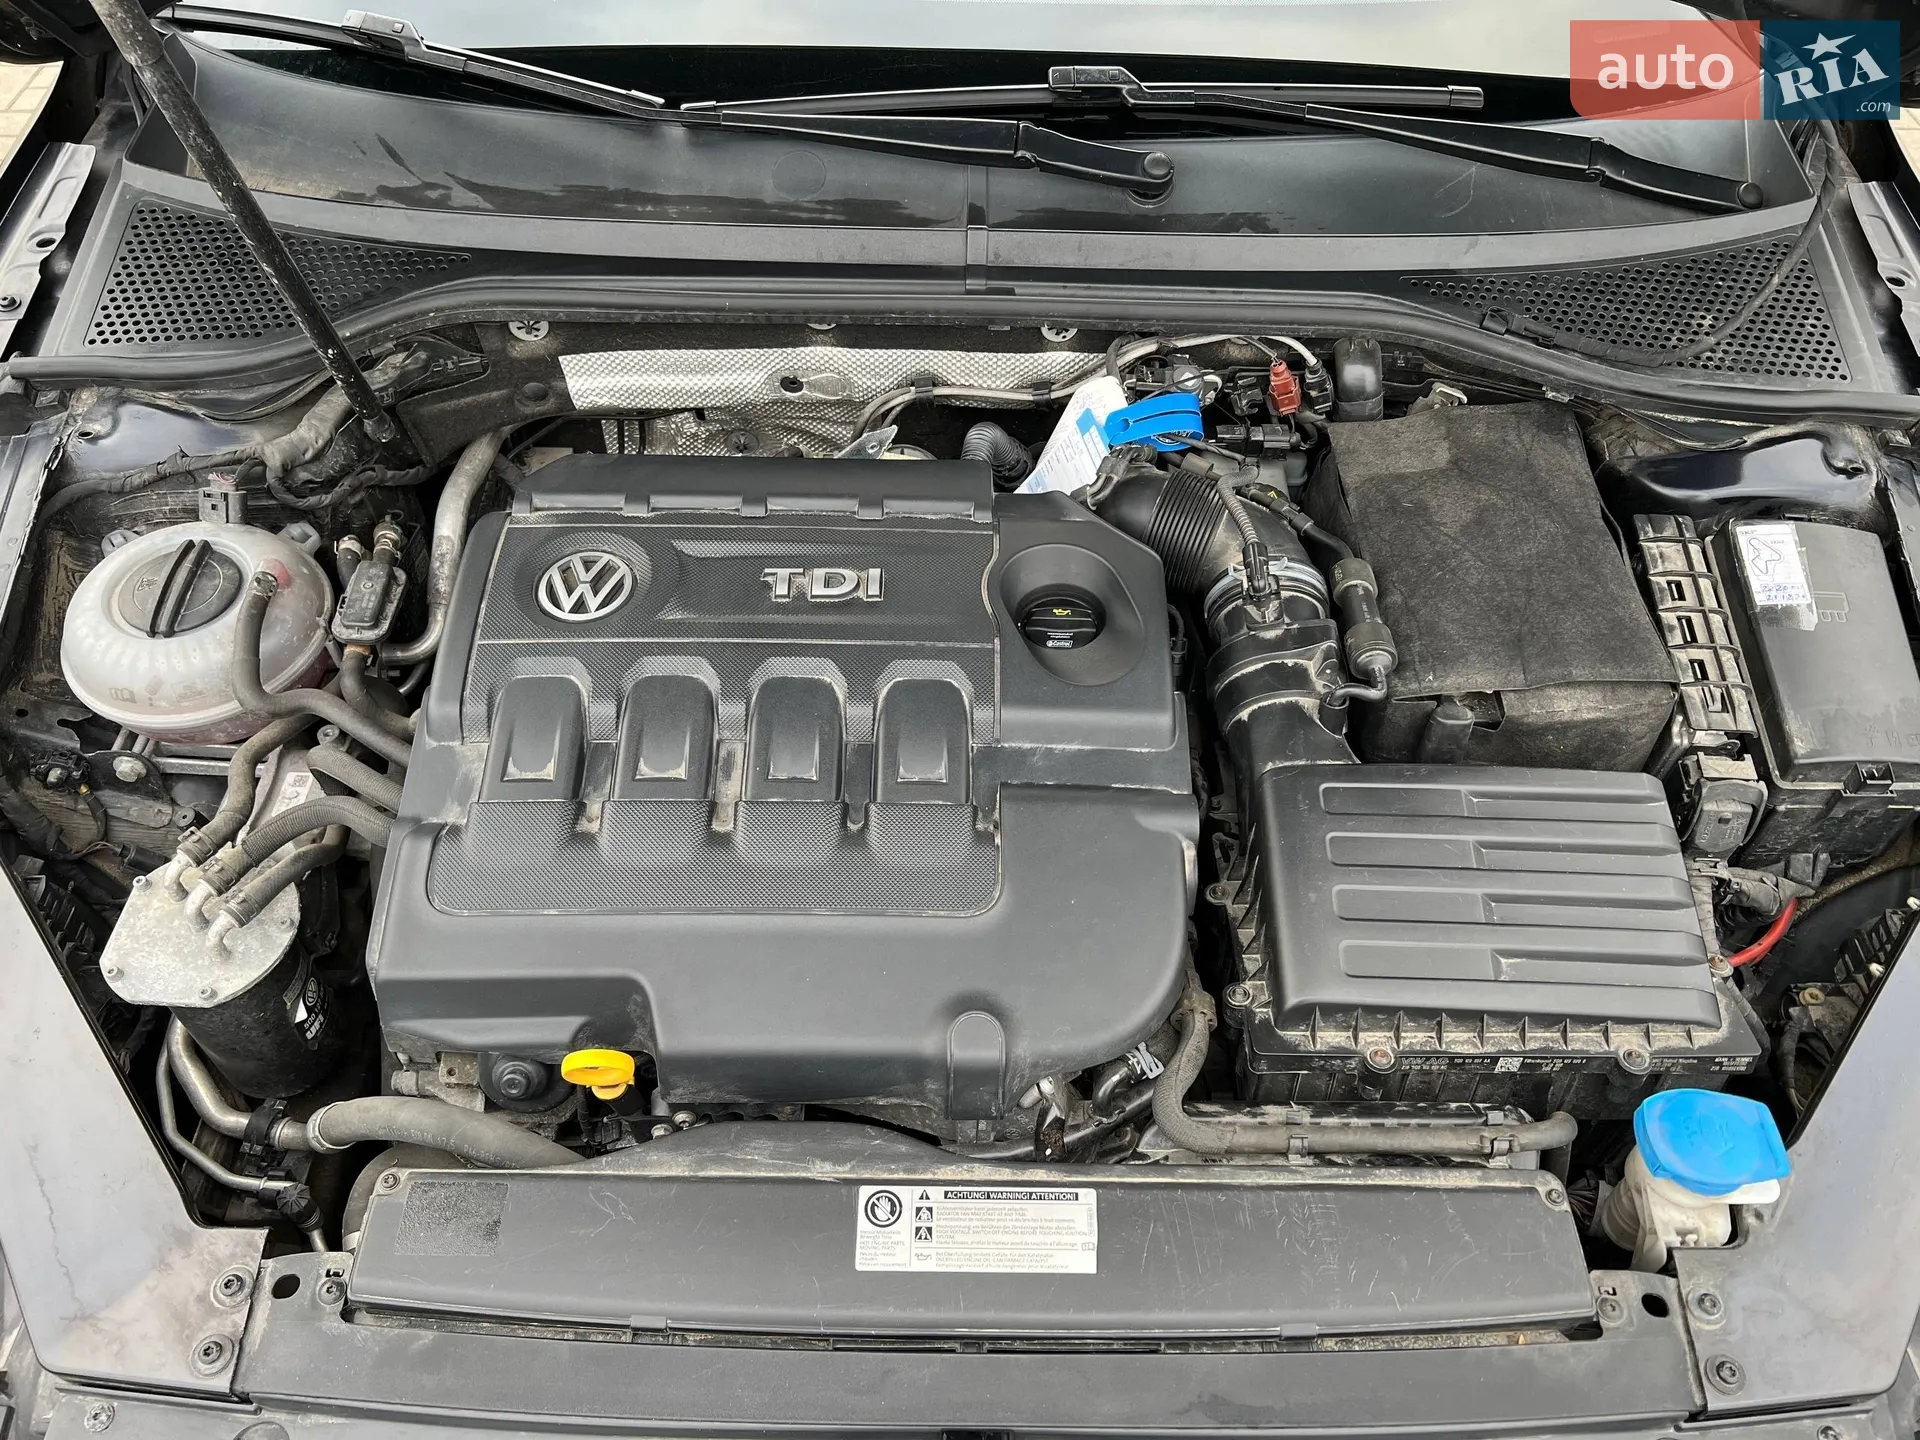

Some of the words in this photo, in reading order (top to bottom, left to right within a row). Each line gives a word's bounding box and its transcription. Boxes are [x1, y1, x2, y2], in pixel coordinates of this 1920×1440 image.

[538, 551, 633, 621] VW
[761, 567, 885, 601] TDI
[946, 1192, 986, 1200] ACHTUNG!
[989, 1192, 1030, 1200] WARNING!
[1031, 1192, 1076, 1200] ATTENTION!
